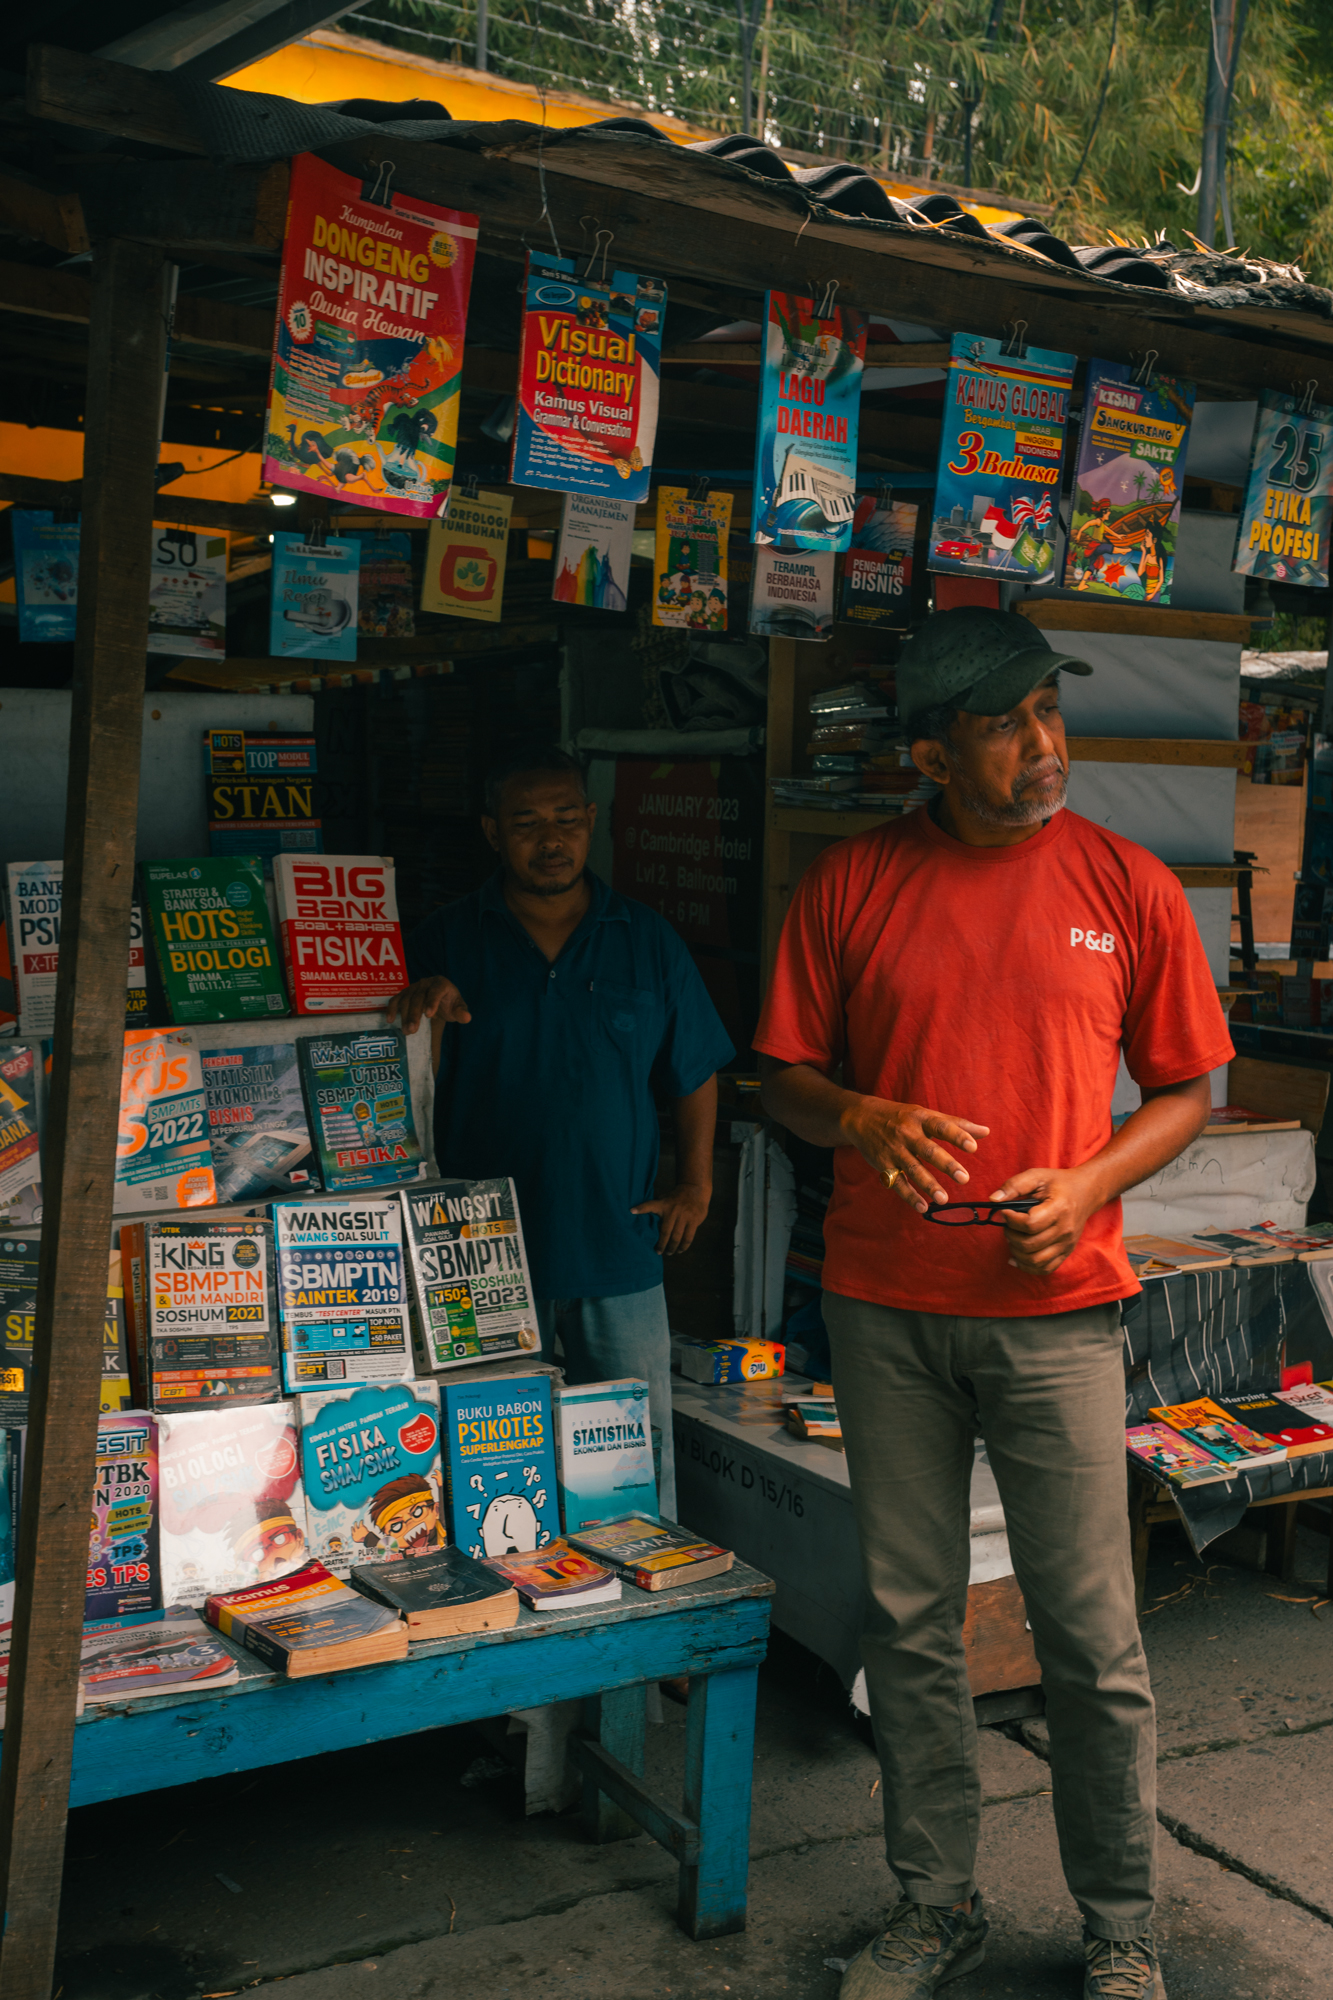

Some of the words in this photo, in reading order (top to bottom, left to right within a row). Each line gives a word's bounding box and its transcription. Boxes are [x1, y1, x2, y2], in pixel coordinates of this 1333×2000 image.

[339, 205, 403, 240] Kumpulan
[312, 215, 429, 283] DONGENG
[435, 241, 452, 250] BEST
[303, 248, 439, 320] INSPIRATIF
[293, 313, 306, 328] 10
[309, 291, 358, 325] Dunia
[362, 309, 425, 344] Hewan
[538, 315, 636, 365] Visual
[536, 350, 635, 405] Dictionary
[779, 371, 826, 407] LAGU
[956, 374, 1008, 413] KAMUS
[1011, 385, 1066, 423] GLOBAL
[534, 391, 585, 414] Kamus
[590, 401, 633, 421] Visual
[1098, 389, 1136, 411] KISAH
[533, 408, 572, 430] Grammar
[572, 415, 579, 430] &
[580, 416, 631, 439] Conversation
[777, 405, 848, 444] DAERAH
[963, 409, 1017, 431] Bergambar
[1030, 425, 1051, 436] ARAB
[1097, 410, 1173, 441] SANGKURIANG
[1024, 435, 1055, 447] INGGRIS
[948, 431, 984, 475] 3
[978, 450, 1060, 485] Bahasa
[1018, 445, 1059, 459] INDONESIA
[1136, 442, 1175, 463] SAKTI
[1266, 424, 1323, 492] 25
[385, 486, 433, 502] Anak-anak
[405, 481, 434, 494] Untuk
[571, 494, 621, 510] ORGANISASI
[571, 503, 628, 522] MANAJEMEN
[1263, 488, 1312, 527] ETIKA
[450, 508, 508, 528] ORFOLOGI
[665, 514, 684, 523] dan
[440, 519, 505, 541] TUMBUHAN
[669, 530, 686, 538] JUZ
[1249, 521, 1320, 561] PROFESI
[283, 570, 327, 586] Ilmu
[773, 560, 817, 578] TERAMPIL
[853, 558, 905, 577] PENGANTAR
[766, 573, 821, 591] BERBAHASA
[851, 571, 904, 596] BISNIS
[282, 589, 327, 604] Resep
[767, 586, 817, 603] INDONESIA
[213, 736, 240, 747] HOTS
[247, 752, 277, 768] TOP
[278, 753, 310, 761] MODUL
[213, 786, 312, 819] STAN
[639, 794, 703, 818] JANUARY
[706, 798, 739, 821] 2023
[626, 827, 636, 848] @
[640, 829, 710, 861] Cambridge
[714, 835, 752, 860] Hotel
[293, 865, 385, 899] BIG
[636, 862, 655, 883] Lvl
[658, 865, 669, 889] 2,
[677, 866, 737, 894] Ballroom
[162, 888, 209, 900] STRATEGI
[212, 887, 219, 897] &
[164, 899, 198, 911] BANK
[200, 897, 231, 909] SOAL
[677, 901, 685, 922] 6
[689, 902, 710, 926] PM
[161, 909, 240, 941] HOTS
[1294, 929, 1315, 939] BUMI
[296, 936, 400, 966] FISIKA
[1070, 927, 1115, 954] P&B
[169, 946, 271, 972] BIOLOGI
[187, 972, 222, 982] SMA/MA
[194, 980, 232, 991] 10,11,12
[300, 971, 337, 981] SMA/MA
[338, 972, 368, 980] KELAS
[389, 972, 396, 980] &
[397, 972, 403, 980] 3
[203, 1055, 243, 1067] PENGANTAR
[204, 1064, 274, 1088] STATISTIK
[352, 1064, 403, 1084] UTBK
[207, 1084, 267, 1107] EKONOMI
[272, 1086, 282, 1100] &
[316, 1085, 376, 1105] SBMPTN
[376, 1083, 403, 1094] 2020
[380, 1100, 399, 1109] HOTS
[151, 1098, 200, 1120] SMP/MTs
[209, 1106, 254, 1126] BISNIS
[150, 1113, 203, 1148] 2022
[220, 1124, 263, 1134] PERGURUAN
[264, 1120, 287, 1129] TINGGI
[336, 1145, 410, 1167] FISIKA
[283, 1210, 388, 1231] WANGSIT
[471, 1224, 501, 1236] HOTS
[282, 1232, 328, 1243] PAWANG
[331, 1232, 359, 1241] SOAL
[360, 1231, 389, 1241] SULIT
[162, 1242, 225, 1270] KING
[419, 1235, 522, 1282] SBMPTN
[155, 1270, 263, 1293] SBMPTN
[283, 1262, 398, 1290] SBMPTN
[471, 1272, 525, 1290] SOSHUM
[159, 1296, 167, 1305] &
[174, 1294, 196, 1305] UM
[200, 1292, 264, 1305] MANDIRI
[285, 1289, 359, 1306] SAINTEK
[362, 1288, 399, 1303] 2019
[474, 1285, 528, 1308] 2023
[156, 1308, 224, 1323] SOSHUM
[228, 1307, 262, 1320] 2021
[286, 1311, 313, 1319] TEMBUS
[384, 1333, 402, 1341] PAKET
[297, 1365, 325, 1374] CBT
[1219, 1392, 1269, 1405] Marrying
[457, 1406, 492, 1421] BUKU
[496, 1400, 542, 1417] BABON
[309, 1429, 337, 1443] KUMPULAN
[337, 1420, 357, 1433] MATERI
[359, 1411, 384, 1425] PANDUAN
[385, 1402, 409, 1415] TERARAH
[458, 1414, 544, 1444] PSIKOTES
[573, 1423, 645, 1446] STATISTIKA
[315, 1425, 386, 1469] FISIKA
[460, 1436, 544, 1456] SUPERLENGKAP
[573, 1446, 606, 1455] EKONOMI
[624, 1440, 646, 1449] BISNIS
[163, 1443, 246, 1488] BIOLOGI
[319, 1446, 402, 1492] SMA/SMK
[691, 1438, 735, 1482] BLOK
[741, 1465, 755, 1489] D
[760, 1476, 805, 1518] 15/16
[115, 1484, 150, 1498] 2020
[115, 1507, 142, 1518] HOTS
[112, 1543, 142, 1559] TPS
[595, 1536, 620, 1549] TES
[611, 1534, 685, 1556] SIMAK
[112, 1563, 150, 1584] TPS
[383, 1570, 412, 1578] KAMUS
[413, 1562, 448, 1573] LENGKAP
[221, 1584, 290, 1605] Kamus
[235, 1583, 332, 1612] Indonesia
[248, 1600, 314, 1620] Inggris
[200, 1645, 215, 1656] 3
